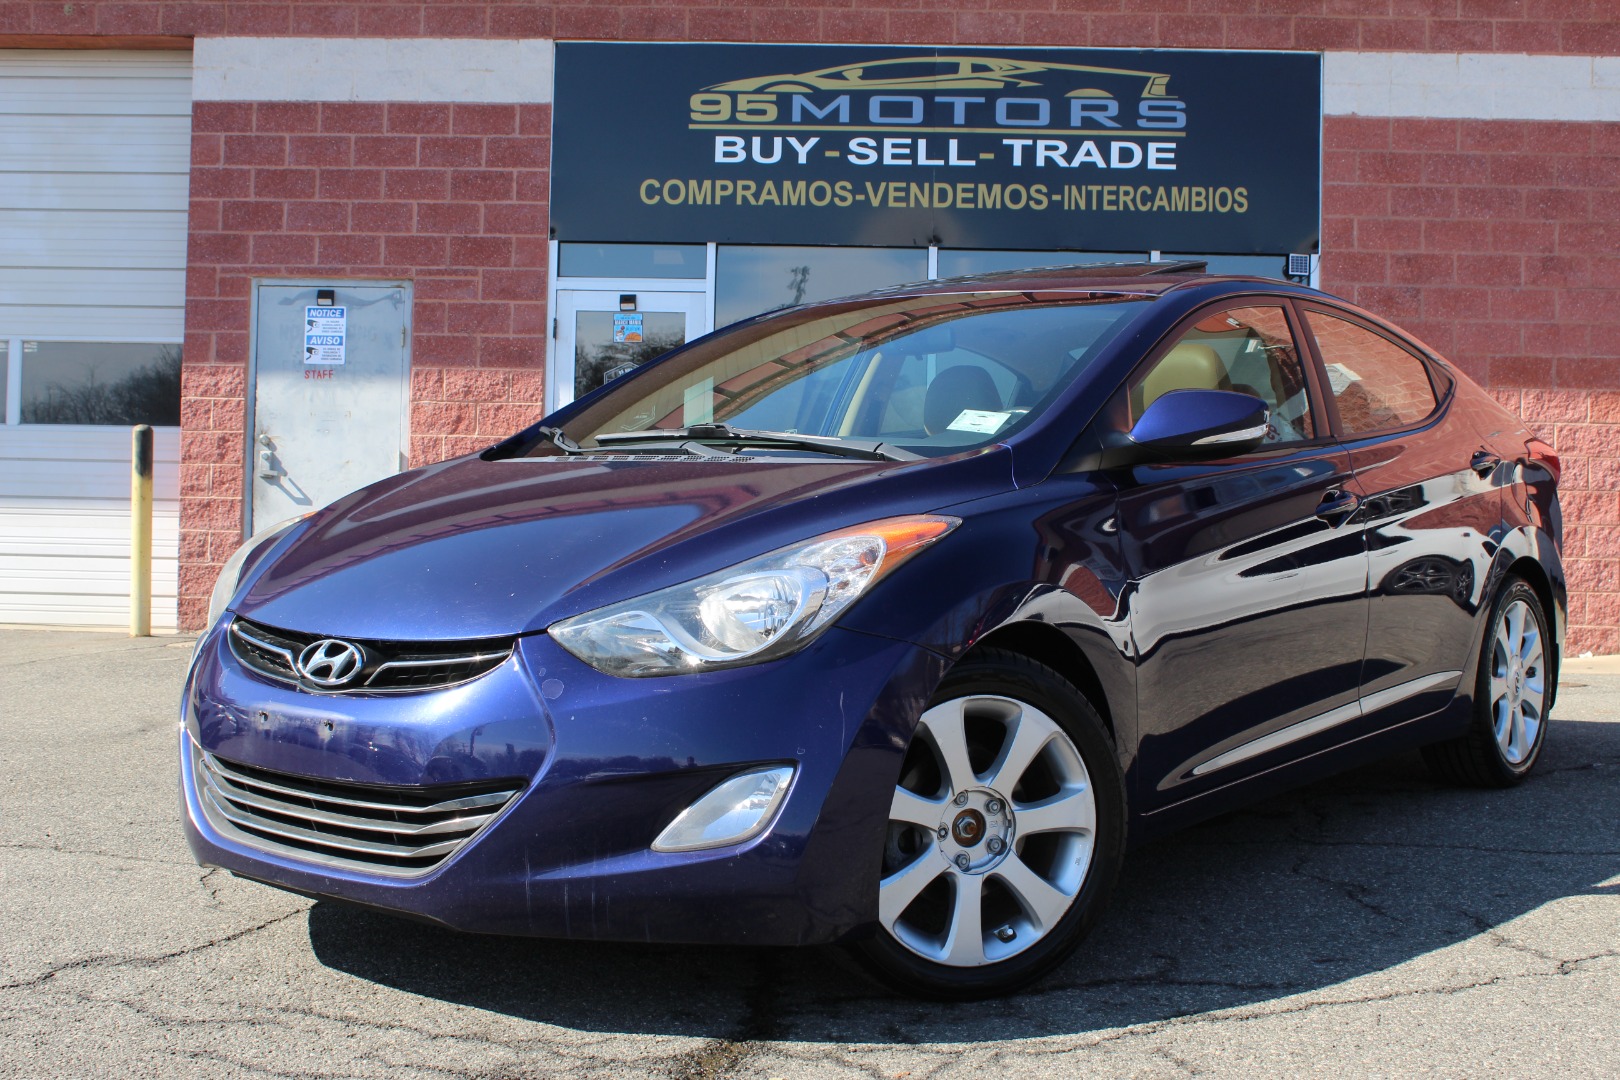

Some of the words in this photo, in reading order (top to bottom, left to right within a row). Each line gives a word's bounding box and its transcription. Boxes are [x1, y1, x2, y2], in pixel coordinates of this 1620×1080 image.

[309, 309, 342, 318] NOTICE
[310, 336, 340, 345] AVISO
[304, 370, 334, 379] STAFF
